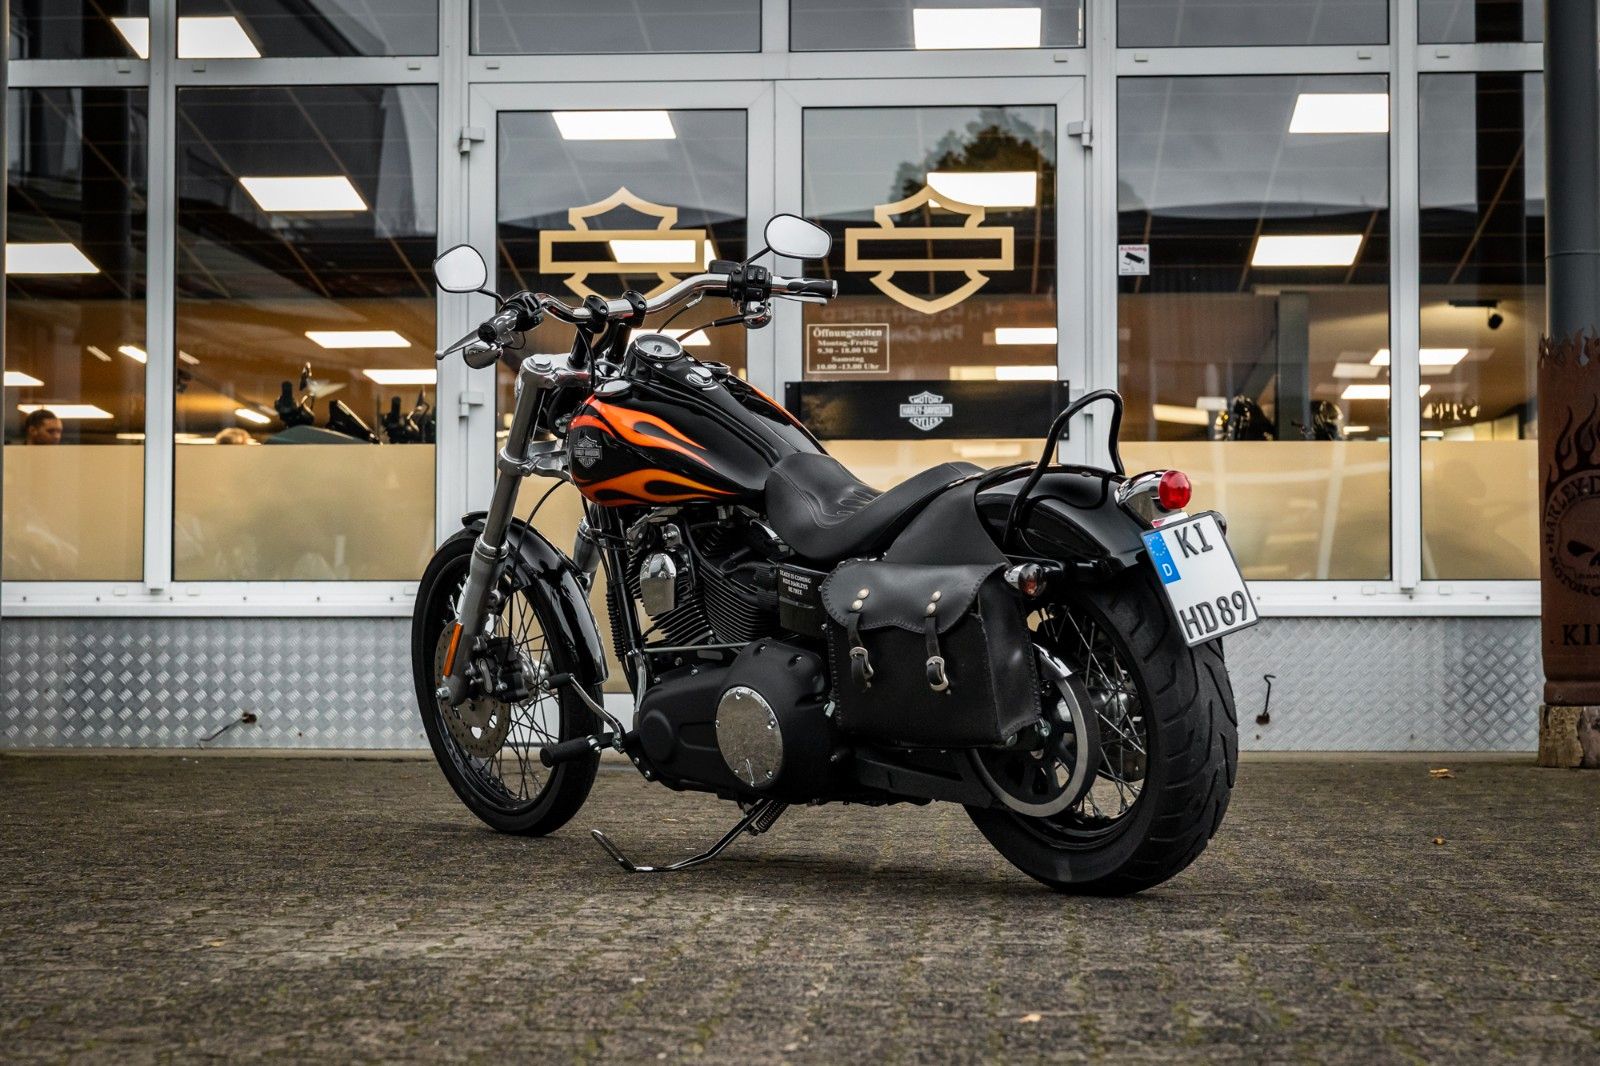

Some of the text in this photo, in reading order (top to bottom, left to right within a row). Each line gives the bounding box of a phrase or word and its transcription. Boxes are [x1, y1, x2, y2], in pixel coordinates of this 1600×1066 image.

[813, 327, 882, 339] Öffnungszeiten
[817, 339, 879, 347] Montag-Freitag
[1174, 522, 1213, 558] KI
[1162, 563, 1173, 577] D
